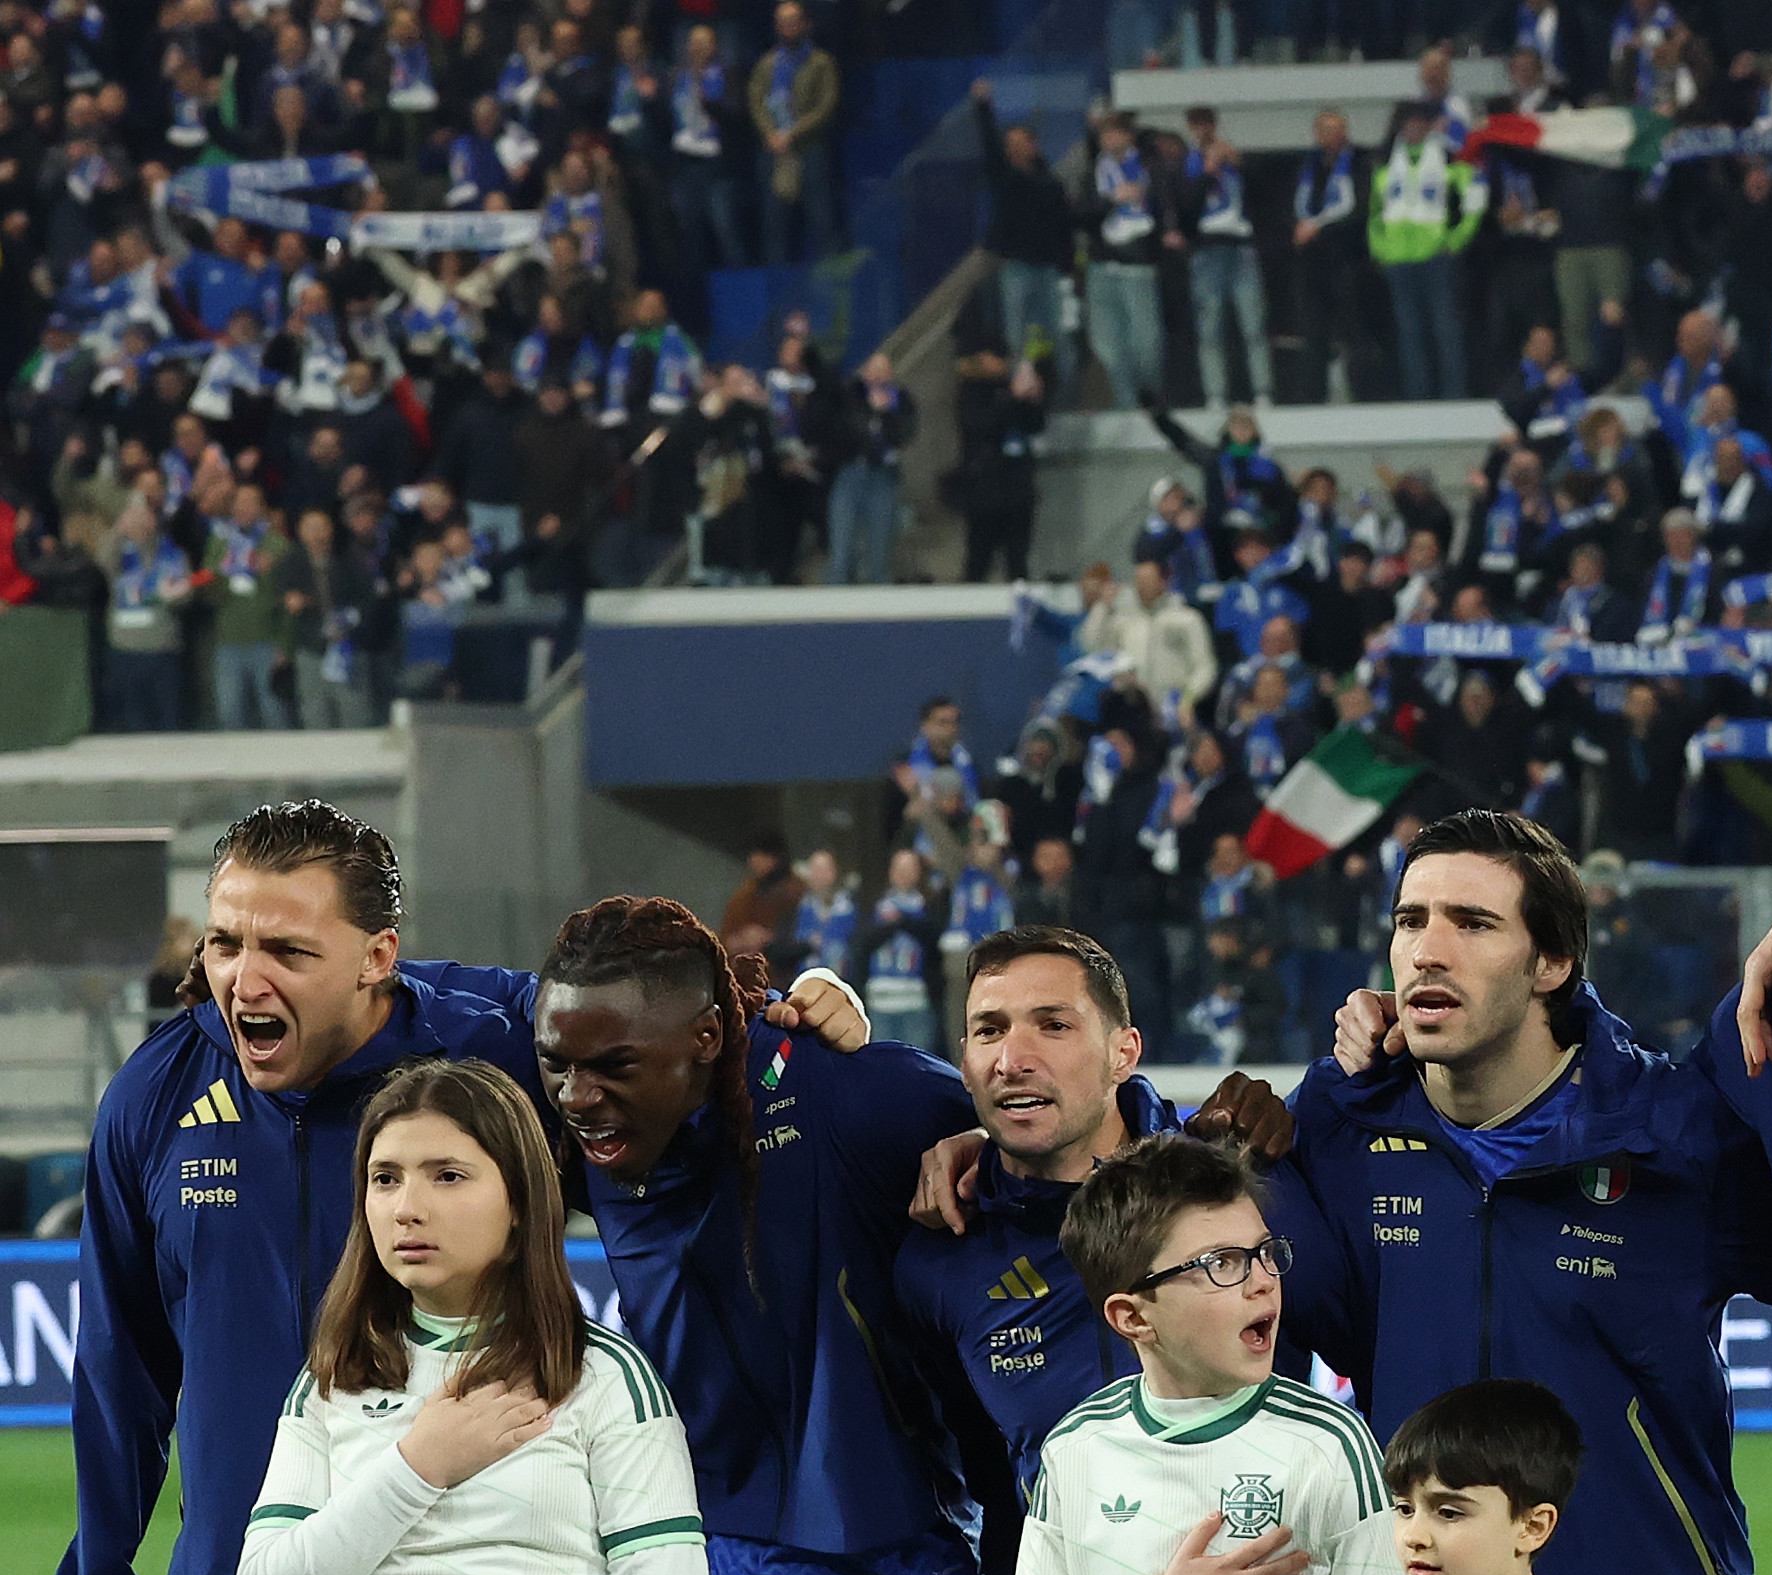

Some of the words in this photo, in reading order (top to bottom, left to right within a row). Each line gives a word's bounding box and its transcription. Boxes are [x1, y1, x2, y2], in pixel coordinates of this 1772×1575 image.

[200, 1158, 238, 1177] TIM
[181, 1186, 238, 1206] Poste
[1389, 1196, 1424, 1216] TIM
[1373, 1222, 1421, 1242] Poste
[1572, 1224, 1625, 1245] Telepass
[1555, 1256, 1591, 1276] eni
[1008, 1326, 1043, 1346] TIM
[990, 1351, 1046, 1373] Poste
